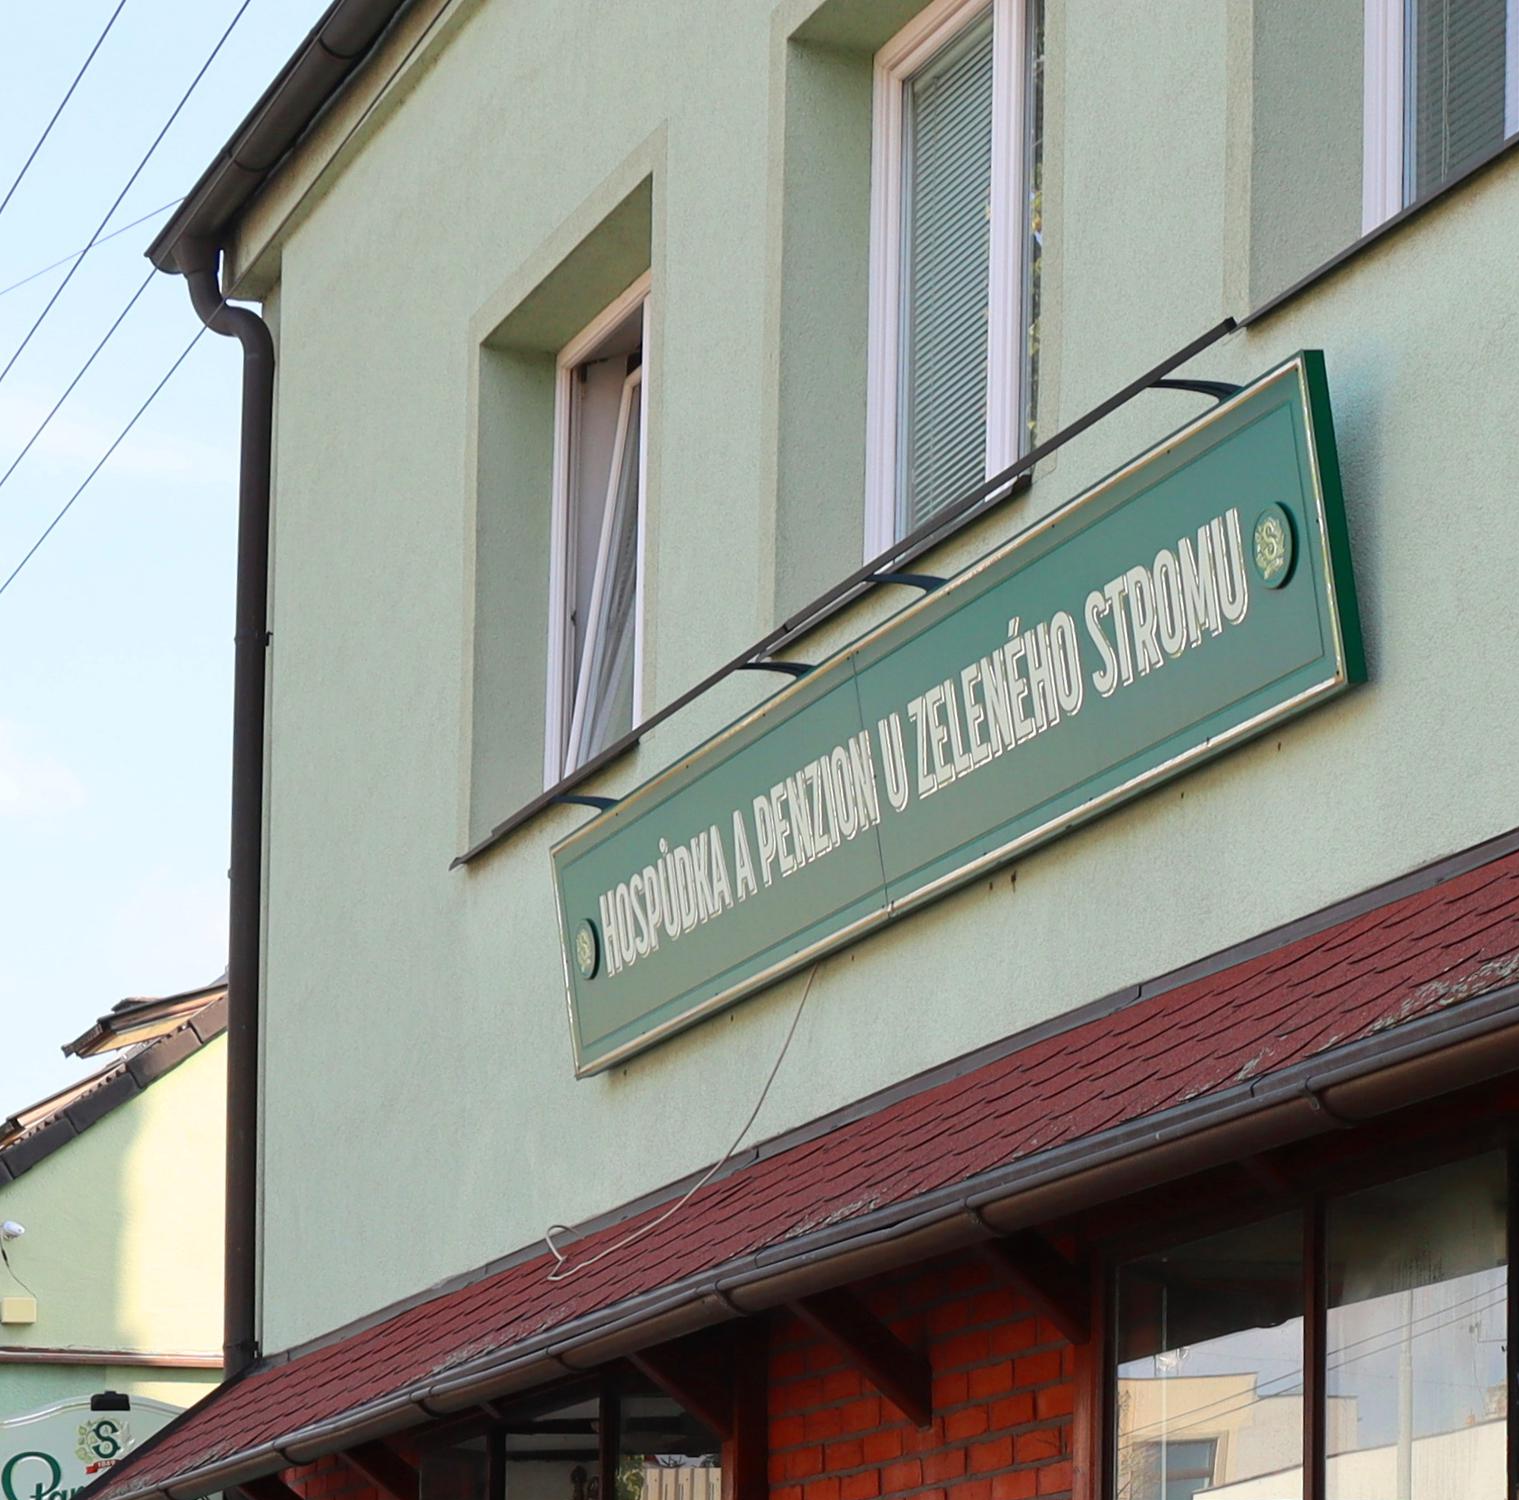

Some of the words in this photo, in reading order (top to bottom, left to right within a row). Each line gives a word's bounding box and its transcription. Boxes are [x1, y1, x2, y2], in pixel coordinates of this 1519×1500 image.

[600, 825, 734, 977] HOSPŮDKA
[733, 810, 757, 902] A
[753, 729, 880, 887] PENZION
[878, 712, 908, 812] U
[907, 611, 1083, 800] ZELENÉHO
[1085, 507, 1248, 698] STROMU
